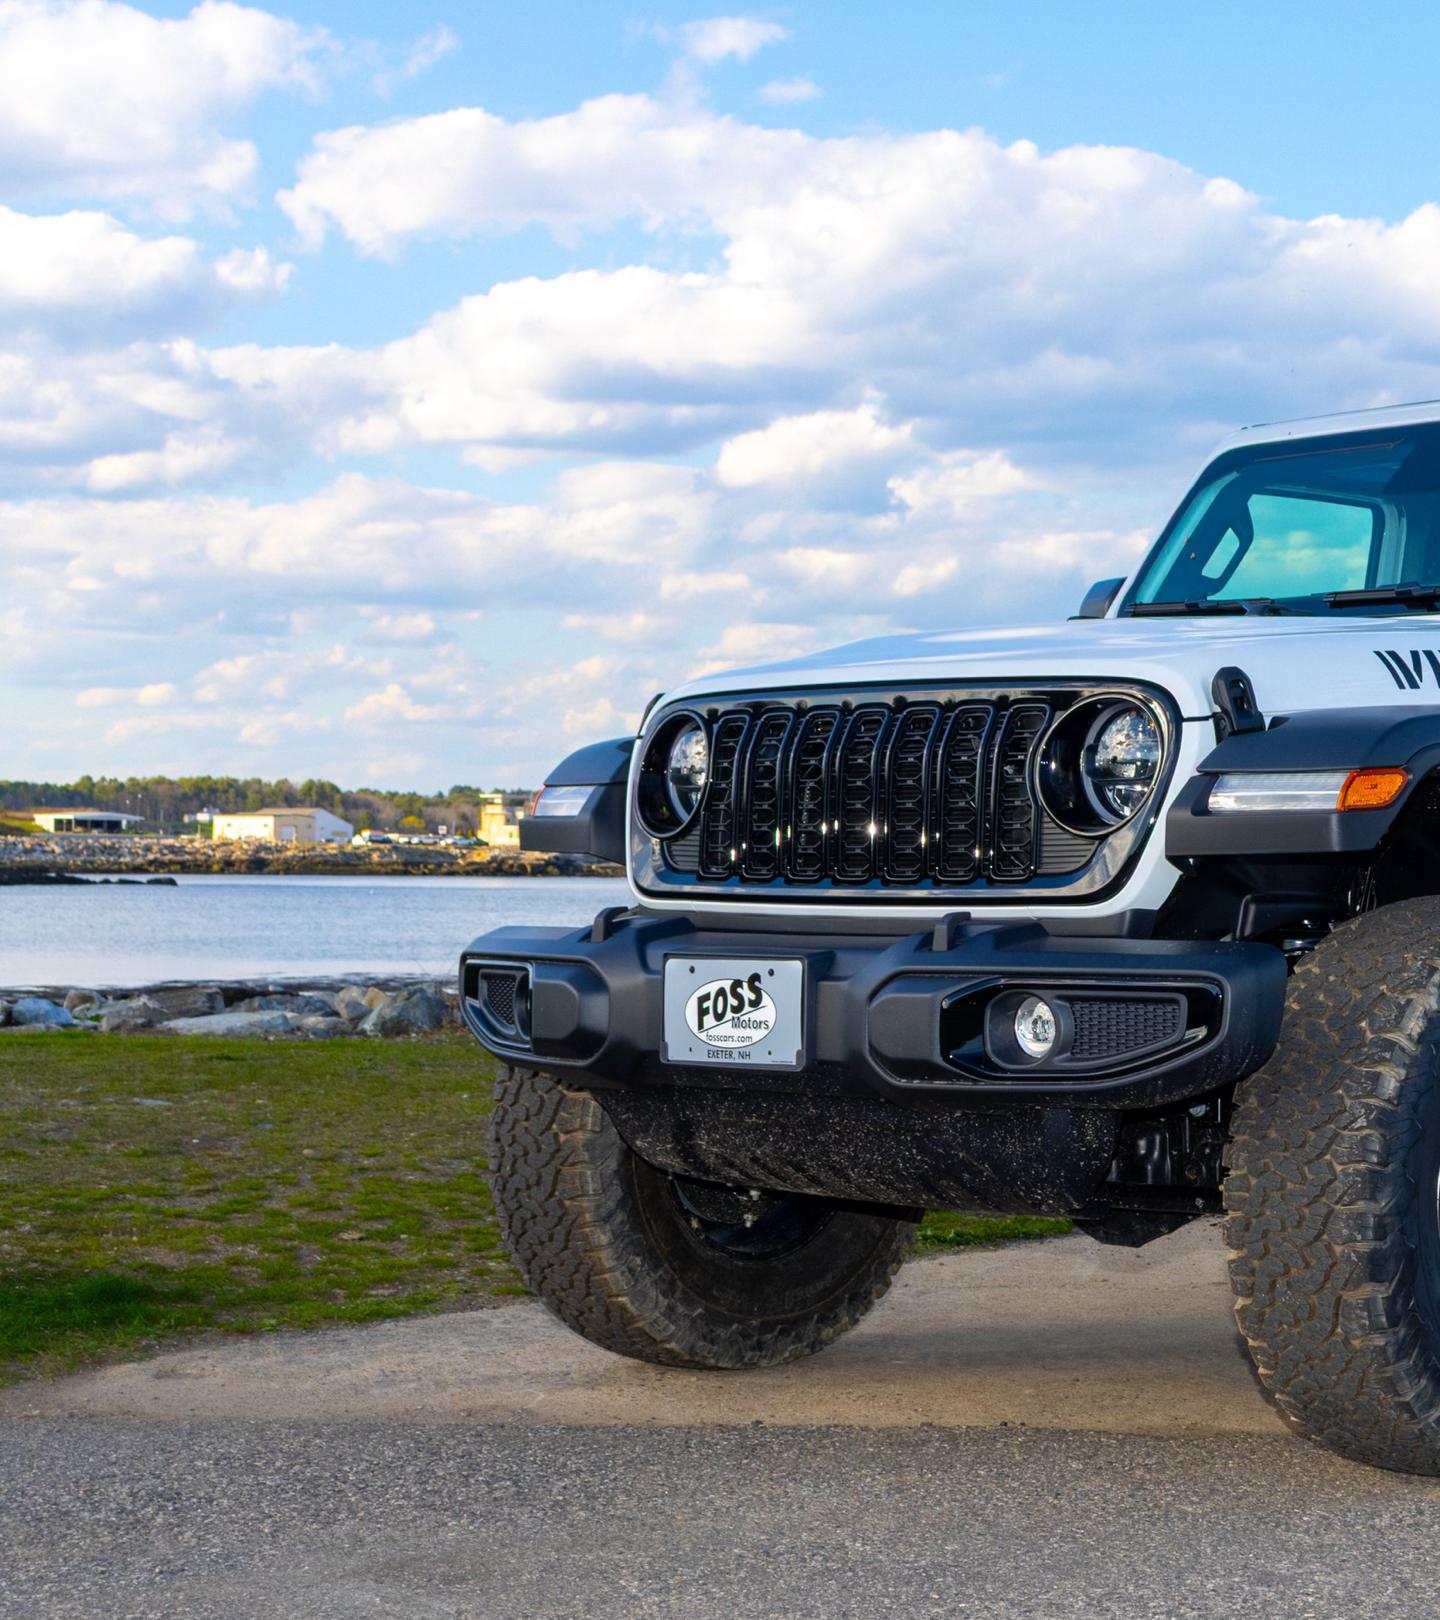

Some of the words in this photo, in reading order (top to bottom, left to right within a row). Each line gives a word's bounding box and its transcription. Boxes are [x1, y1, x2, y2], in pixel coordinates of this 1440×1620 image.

[697, 972, 763, 1032] FOSS
[731, 1015, 770, 1030] Motors
[706, 1031, 753, 1043] fosscars.com
[707, 1049, 736, 1061] EXETER,
[738, 1050, 751, 1060] NH
